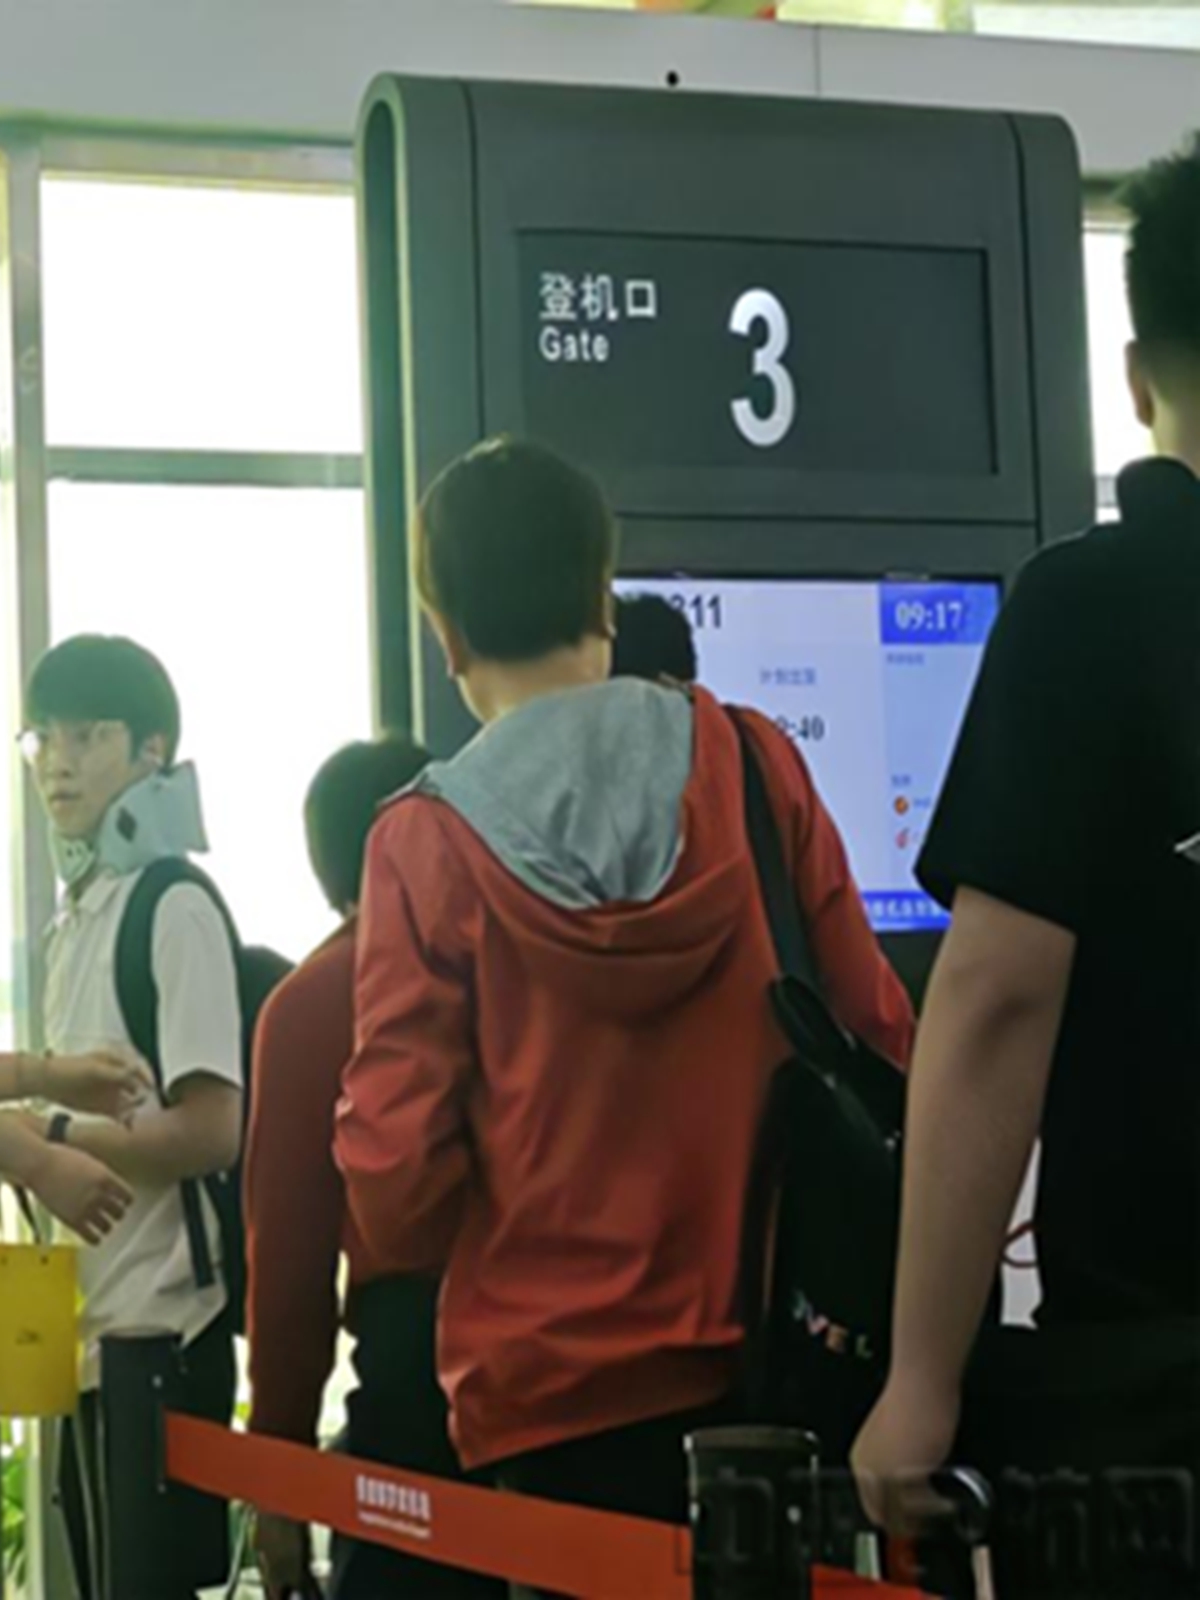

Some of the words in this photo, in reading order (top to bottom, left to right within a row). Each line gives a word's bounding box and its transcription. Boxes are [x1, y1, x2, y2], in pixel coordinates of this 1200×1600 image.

[538, 270, 657, 322] 登机口
[538, 325, 610, 363] Gate
[728, 286, 796, 446] 3
[894, 602, 963, 631] 09:17
